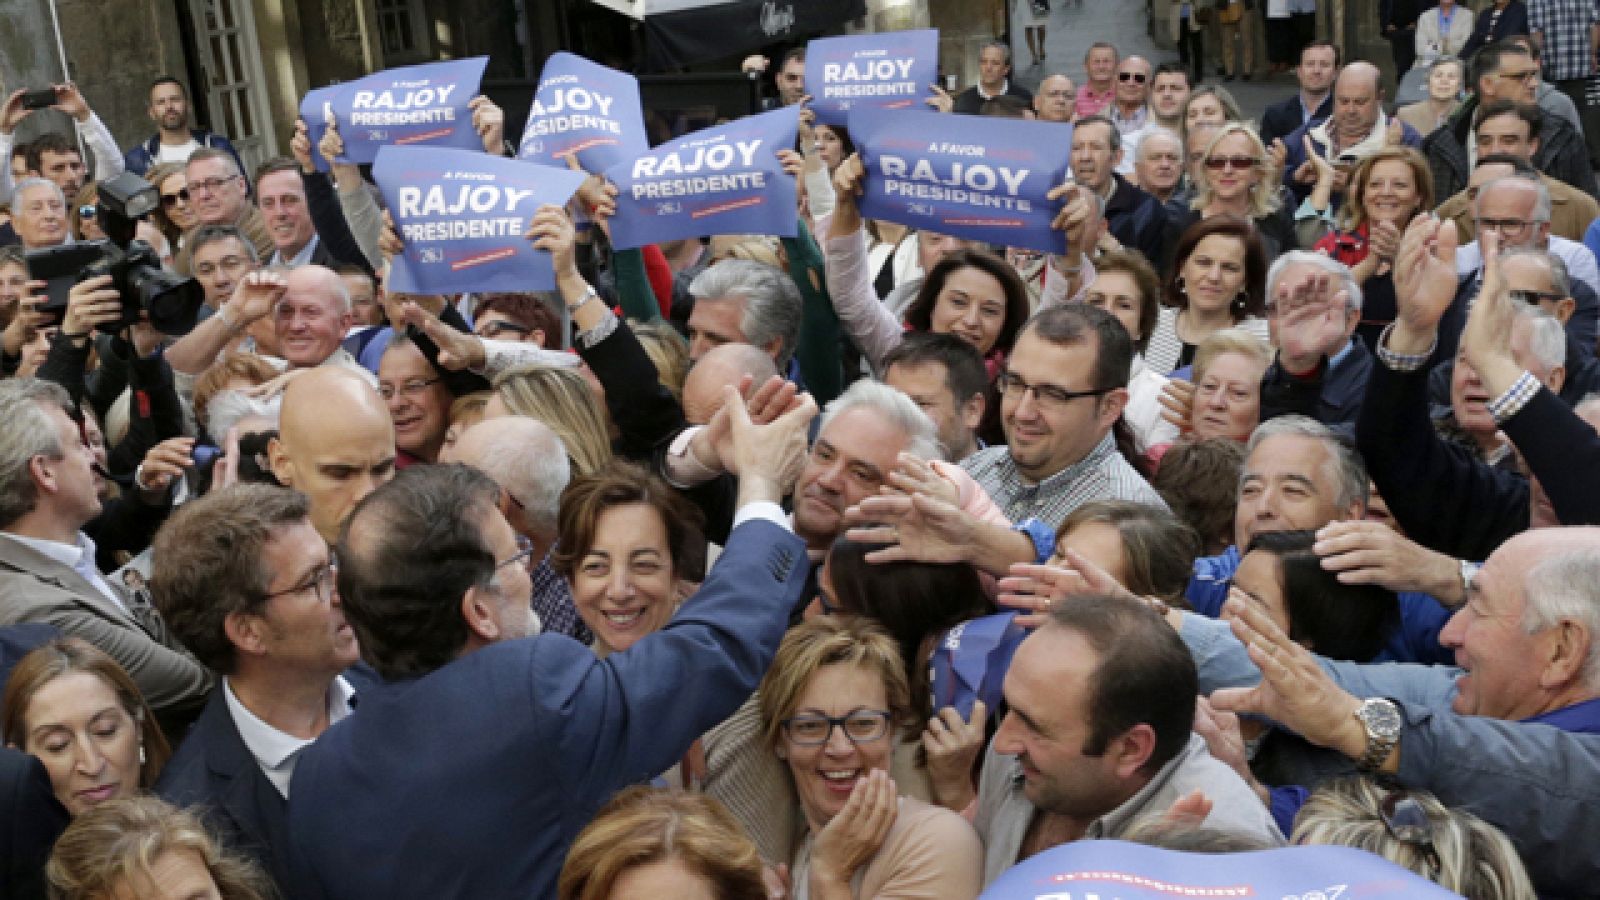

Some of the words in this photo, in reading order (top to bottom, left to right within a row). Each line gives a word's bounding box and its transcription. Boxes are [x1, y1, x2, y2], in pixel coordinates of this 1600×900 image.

[824, 57, 915, 84] RAJOY
[352, 83, 456, 109] RAJOY
[530, 86, 614, 117] AJOY
[824, 80, 916, 99] PRESIDENTE
[351, 107, 456, 126] PRESIDENTE
[632, 139, 763, 179] RAJOY
[940, 143, 985, 156] FAVOR
[632, 171, 766, 201] PRESIDENTE
[880, 154, 1031, 196] RAJOY
[399, 184, 535, 219] RAJOY
[884, 179, 1033, 213] PRESIDENTE
[402, 217, 523, 242] PRESIDENTE
